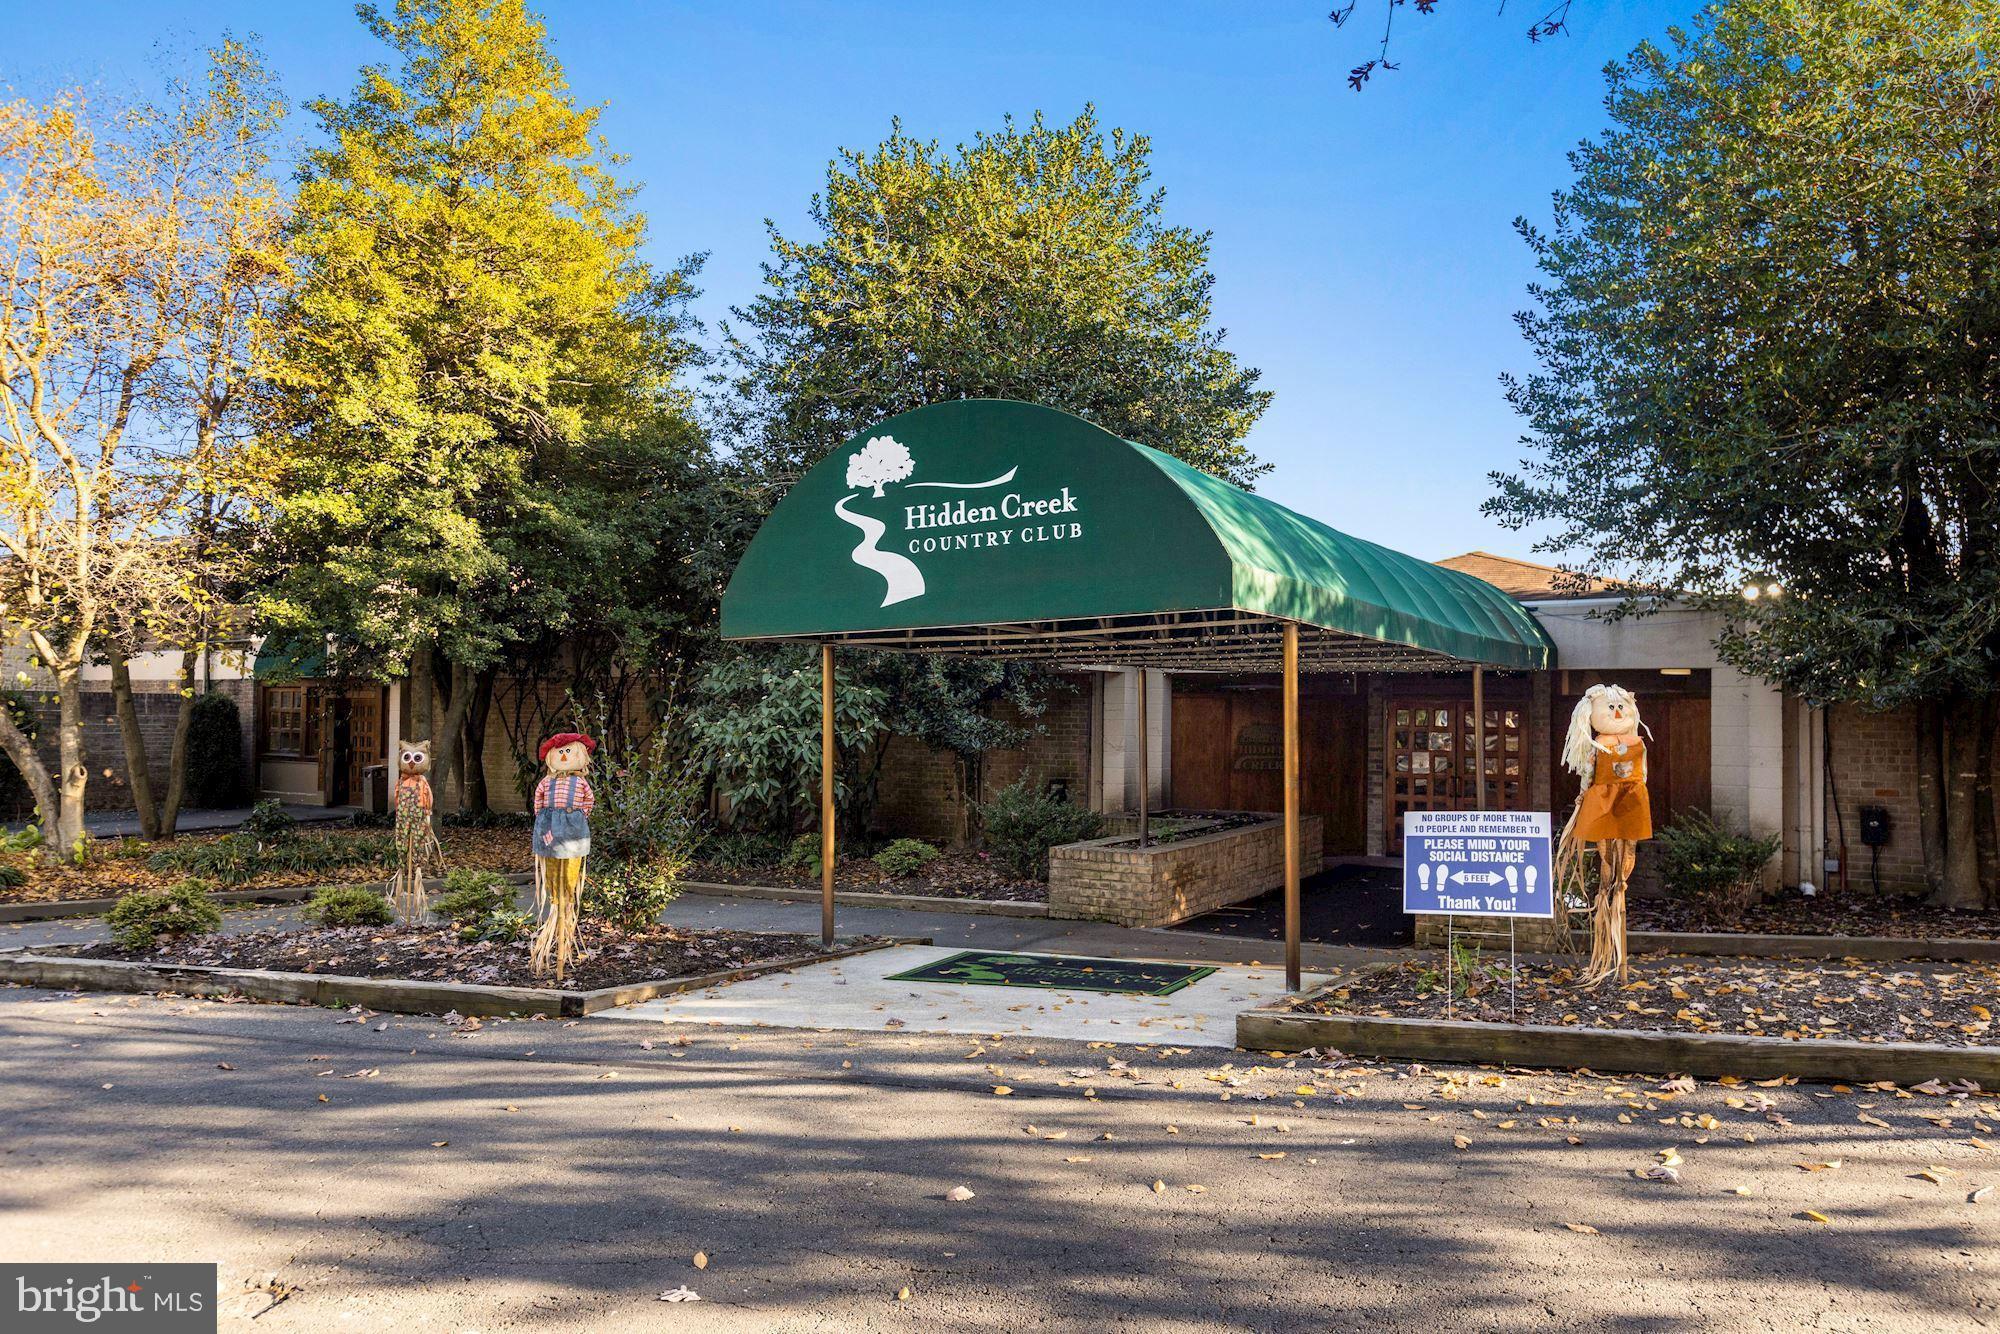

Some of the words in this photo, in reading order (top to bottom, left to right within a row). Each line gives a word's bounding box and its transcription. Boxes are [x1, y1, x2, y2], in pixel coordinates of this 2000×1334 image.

[904, 500, 998, 530] Hidden
[1001, 487, 1077, 518] Creek
[909, 529, 1013, 553] COUNTRY
[1021, 523, 1082, 543] CLUB
[1422, 814, 1433, 822] NO
[1435, 814, 1468, 822] GROUPS
[1470, 814, 1480, 822] OF
[1483, 814, 1507, 822] MORE
[1510, 814, 1532, 823] THAN
[1414, 825, 1424, 833] 10
[1426, 825, 1457, 833] PEOPLE
[1460, 825, 1476, 833] AND
[1479, 825, 1527, 834] REMEMBER
[1530, 825, 1540, 834] TO
[1424, 838, 1464, 850] PLEASE
[1467, 839, 1496, 850] MIND
[1500, 839, 1530, 851] YOUR
[1429, 851, 1468, 862] SOCIAL
[1471, 851, 1524, 863] DISTANCE
[1471, 874, 1489, 882] FEET
[1438, 895, 1480, 910] Thank
[1484, 896, 1516, 911] You!
